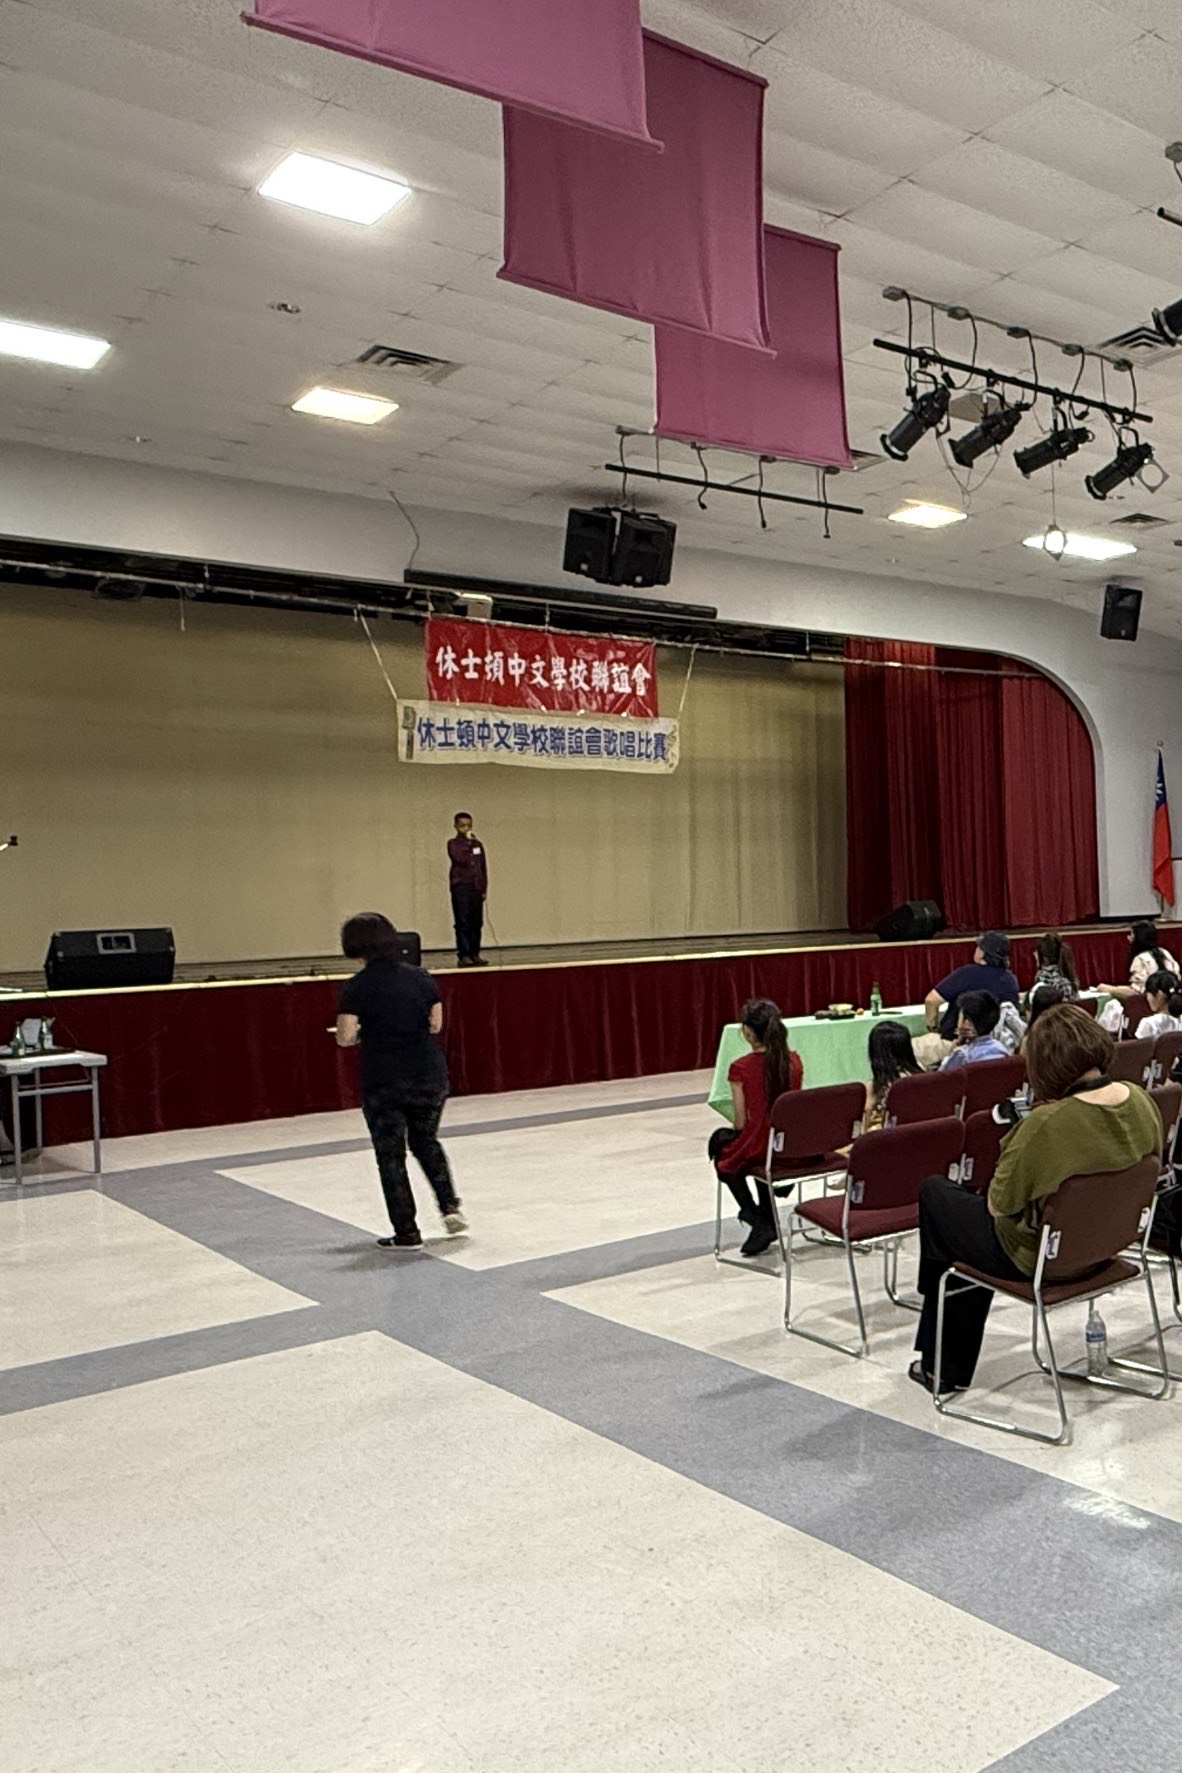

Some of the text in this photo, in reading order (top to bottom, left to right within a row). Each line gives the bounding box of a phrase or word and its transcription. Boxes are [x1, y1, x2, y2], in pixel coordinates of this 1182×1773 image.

[436, 645, 651, 696] 休士頓中文學校聯誼會
[417, 717, 667, 760] 休士頓中文學校聯誼會歌唱比賽
